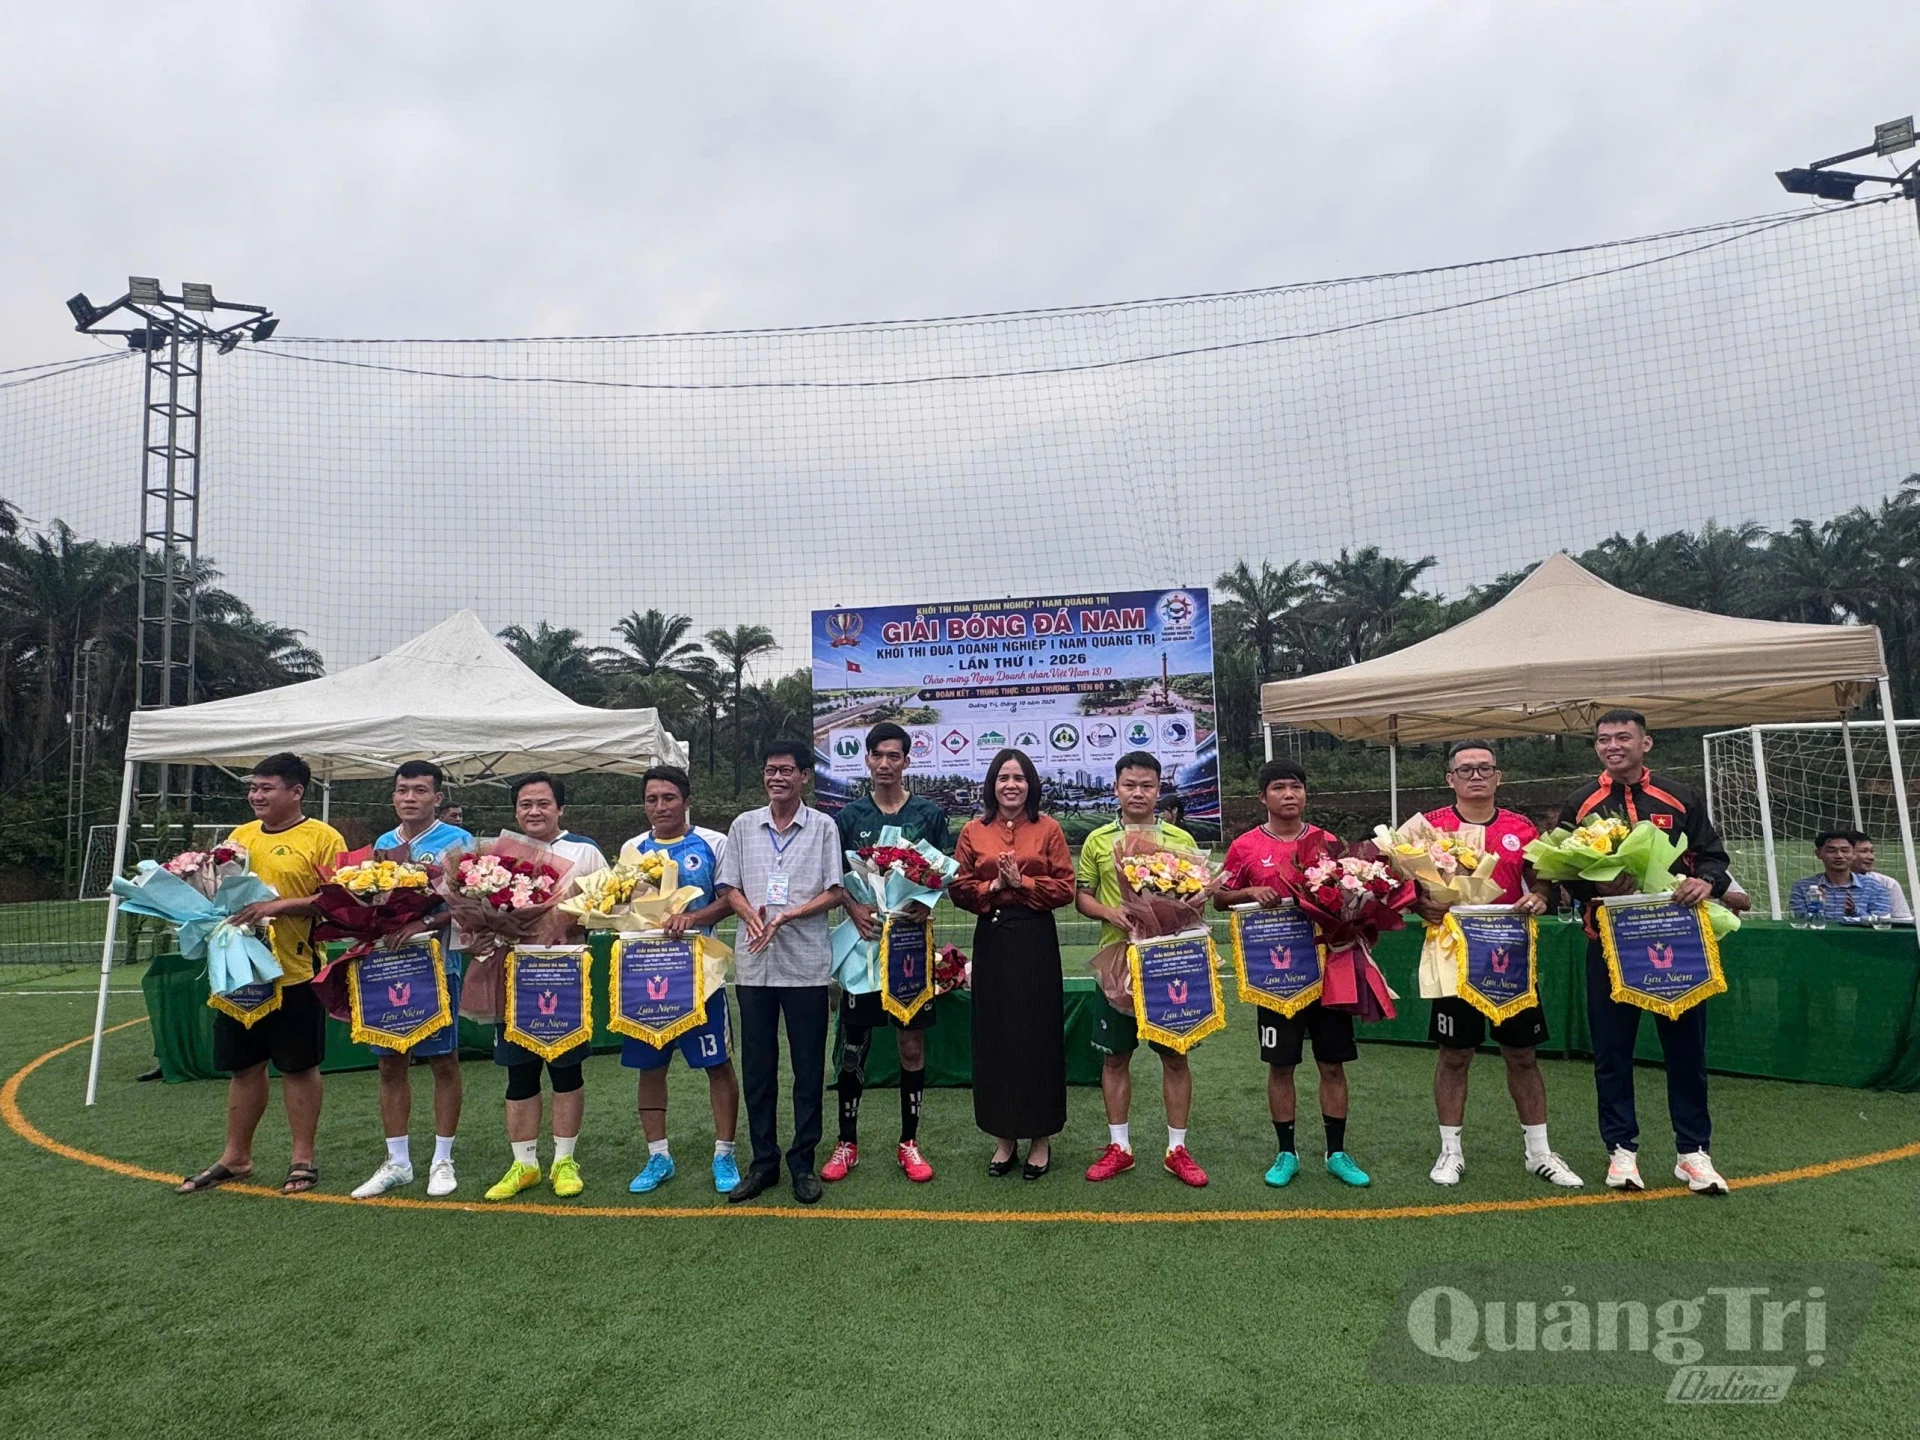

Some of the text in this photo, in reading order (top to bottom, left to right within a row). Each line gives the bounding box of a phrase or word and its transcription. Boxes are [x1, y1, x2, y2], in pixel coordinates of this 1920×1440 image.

[917, 605, 936, 615] KHỐI
[939, 605, 951, 613] THI
[953, 604, 970, 612] ĐUA
[972, 602, 1001, 612] DOANH
[1003, 600, 1034, 610] NGHIỆP
[1042, 598, 1062, 608] NAM
[1064, 597, 1094, 607] QUẢNG
[1096, 596, 1110, 606] TRỊ
[882, 608, 1146, 644] GIẢI BÓNG ĐÁ NAM
[876, 633, 1156, 659] KHỐI THI ĐUA DOANH NGHIỆP I NAM QUẢNG TRỊ
[995, 653, 1024, 668] THỨ
[1028, 655, 1033, 667] I
[1049, 653, 1087, 666] 2026
[996, 670, 1026, 681] Doanh
[1049, 667, 1067, 679] Việt
[1067, 666, 1090, 678] Nam
[1091, 667, 1112, 677] 13/10
[976, 688, 999, 697] TRUNG
[1026, 686, 1040, 694] CAO
[1437, 1012, 1454, 1037] 81
[698, 1033, 718, 1058] 13
[1260, 1025, 1277, 1048] 10
